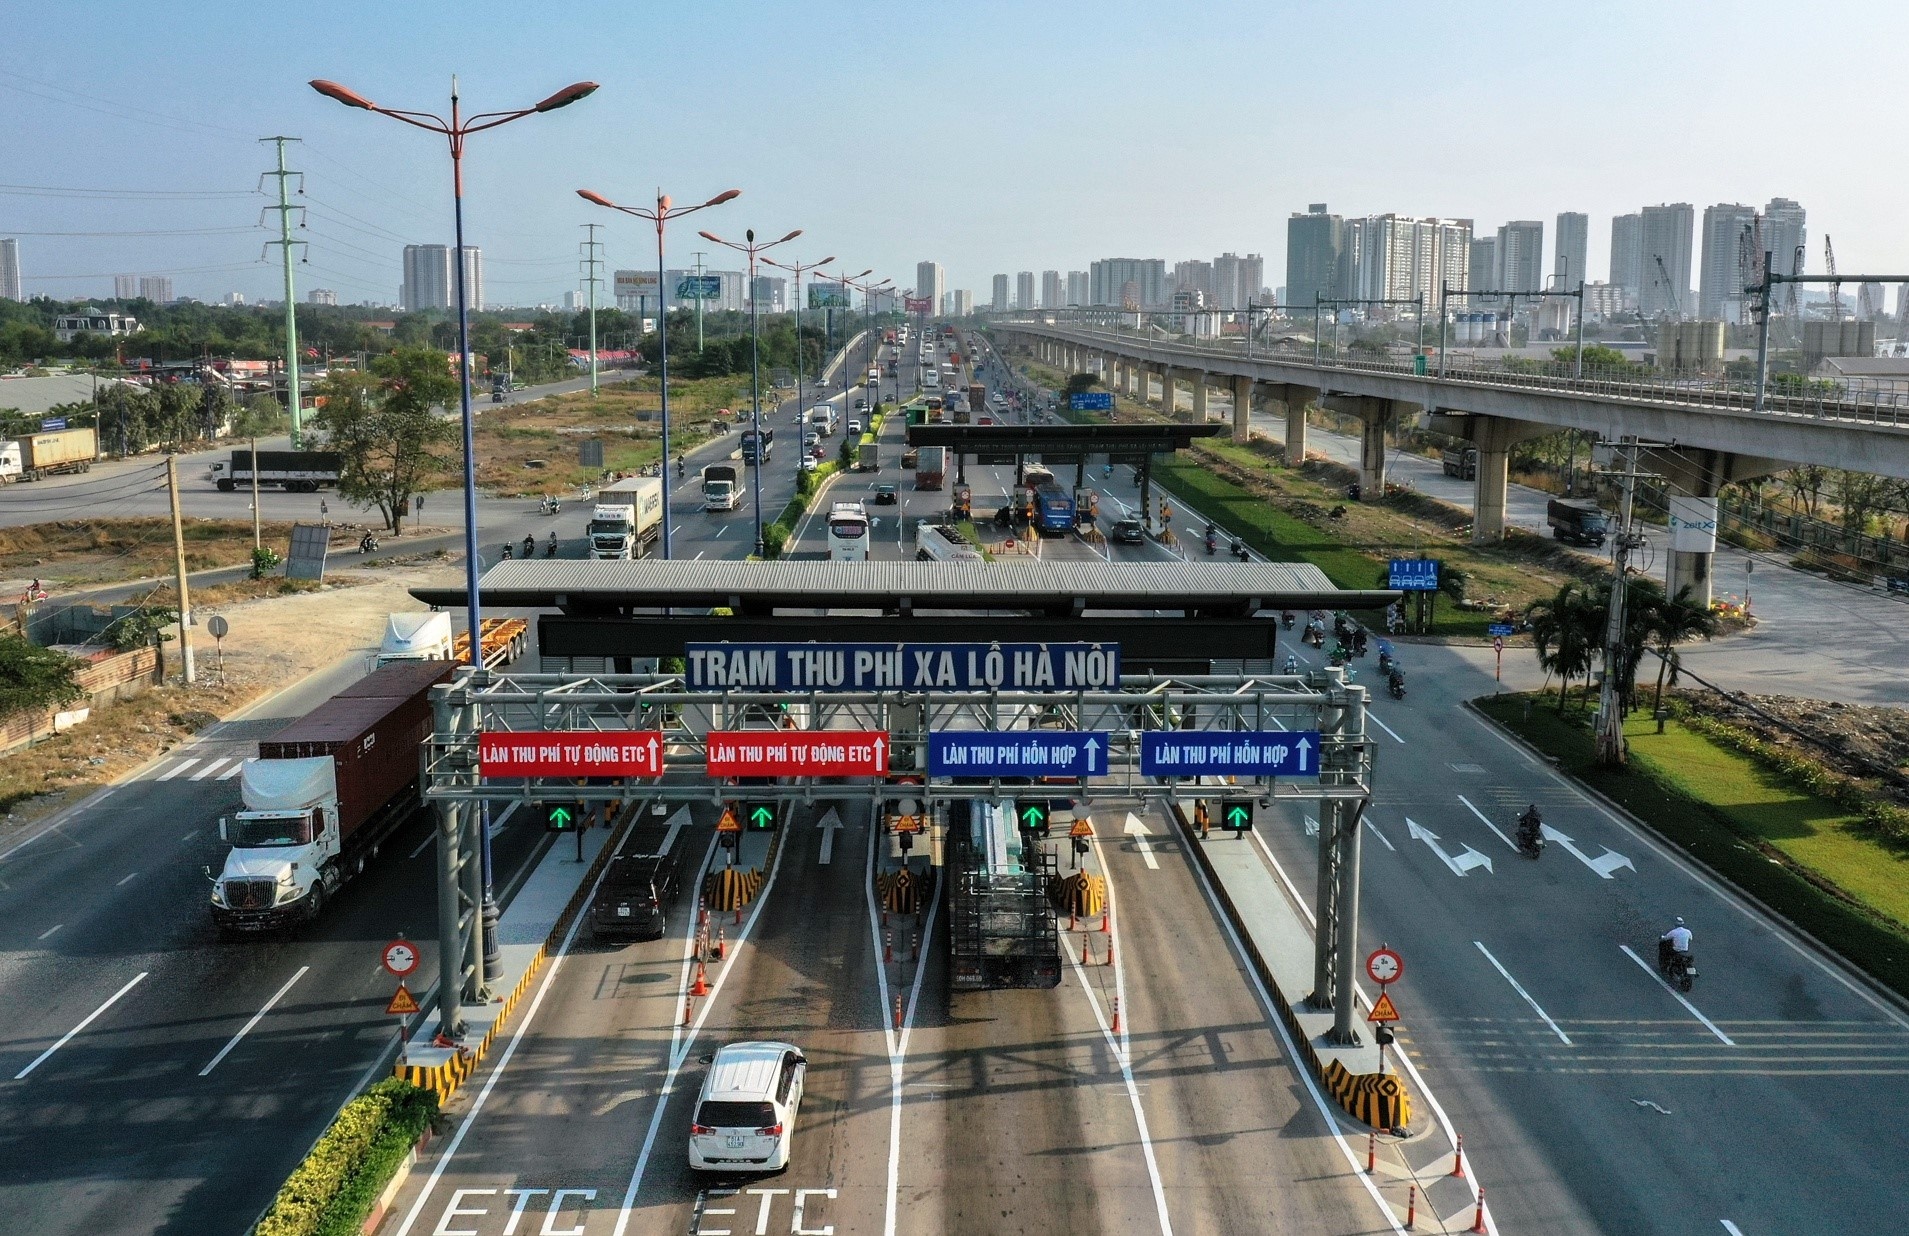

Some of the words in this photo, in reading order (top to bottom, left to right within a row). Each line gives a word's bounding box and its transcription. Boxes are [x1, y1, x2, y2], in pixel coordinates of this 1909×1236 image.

[689, 650, 776, 691] TRẠM
[787, 650, 845, 685] THU
[854, 644, 905, 686] PHÍ
[914, 650, 957, 687] XA
[1014, 643, 1057, 686] HÀ
[1065, 643, 1116, 691] NỘI
[483, 743, 508, 763] LÀN
[512, 746, 536, 763] THU
[540, 743, 561, 763] PHÍ
[564, 745, 582, 766] TỰ
[584, 743, 619, 766] ĐỘNG
[622, 746, 645, 763] ETC
[710, 743, 735, 763] LÀN
[739, 746, 763, 763] THU
[767, 743, 787, 763] PHÍ
[791, 745, 808, 766] TỰ
[811, 743, 845, 766] ĐỘNG
[849, 746, 871, 763] ETC
[943, 743, 967, 765] LÀN
[971, 746, 994, 765] THU
[998, 743, 1019, 765] PHÍ
[1022, 740, 1048, 765] HỖN
[1052, 745, 1077, 768] HỢP
[1155, 743, 1180, 765] LÀN
[1183, 746, 1207, 765] THU
[1210, 743, 1231, 764] PHÍ
[1234, 740, 1260, 764] HỖN
[1264, 745, 1289, 768] HỢP
[434, 1189, 597, 1236] ETC
[688, 1189, 838, 1236] ETC
